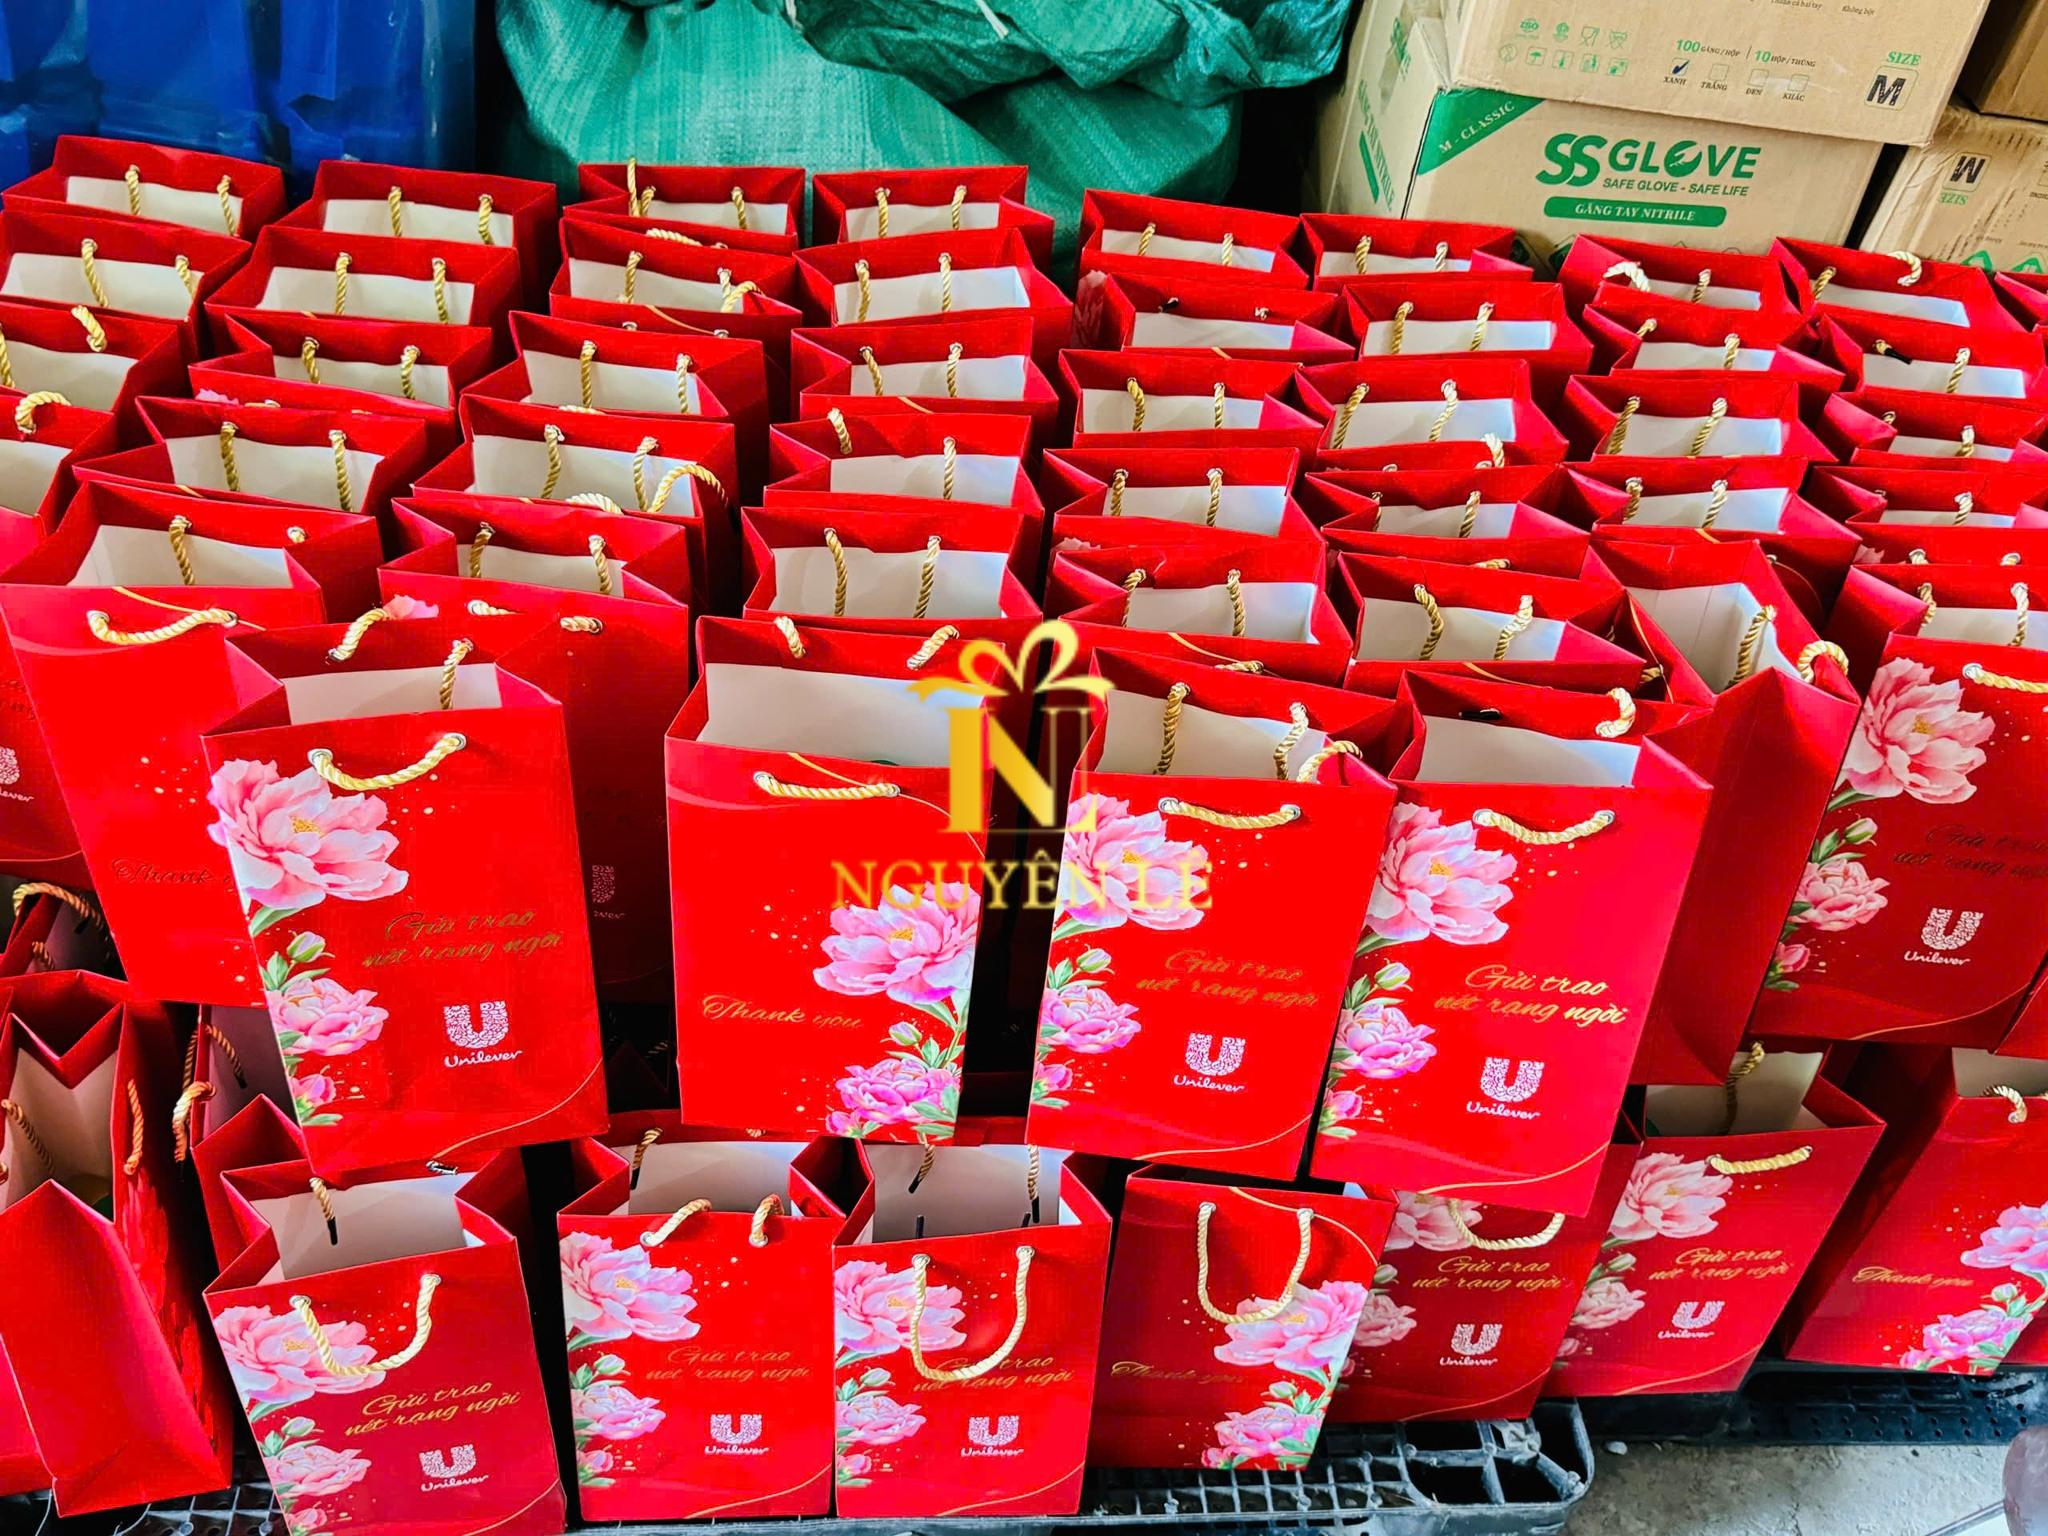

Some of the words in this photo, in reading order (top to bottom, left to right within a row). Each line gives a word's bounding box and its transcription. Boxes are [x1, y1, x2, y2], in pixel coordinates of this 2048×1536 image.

[1676, 39, 1700, 53] 100
[1755, 50, 1771, 63] 10
[1887, 51, 1921, 66] SIZE
[1663, 76, 1687, 86] XANH
[1867, 74, 1907, 106] M
[1460, 101, 1515, 140] CLASSIC
[1603, 178, 1635, 190] SAFE
[1637, 180, 1678, 192] GLOVE
[1688, 183, 1721, 195] SAFE
[1722, 185, 1749, 197] LIFE
[1615, 206, 1640, 217] TAY
[1641, 208, 1696, 221] NITRILE
[1904, 950, 1971, 965] Unilever
[1539, 975, 1609, 996] trao
[702, 994, 806, 1024] Thank
[1564, 1003, 1629, 1028] ngời
[444, 1050, 523, 1067] Unilever
[1174, 1074, 1245, 1092] Unilever
[1466, 1100, 1541, 1120] Unilever
[1497, 1262, 1550, 1273] trao
[1852, 1266, 1934, 1284] Thank
[1439, 1356, 1498, 1366] Unilever
[433, 1382, 493, 1402] trao
[704, 1444, 770, 1456] Unilever
[960, 1446, 1025, 1458] Unilever
[421, 1475, 490, 1492] Unilever
